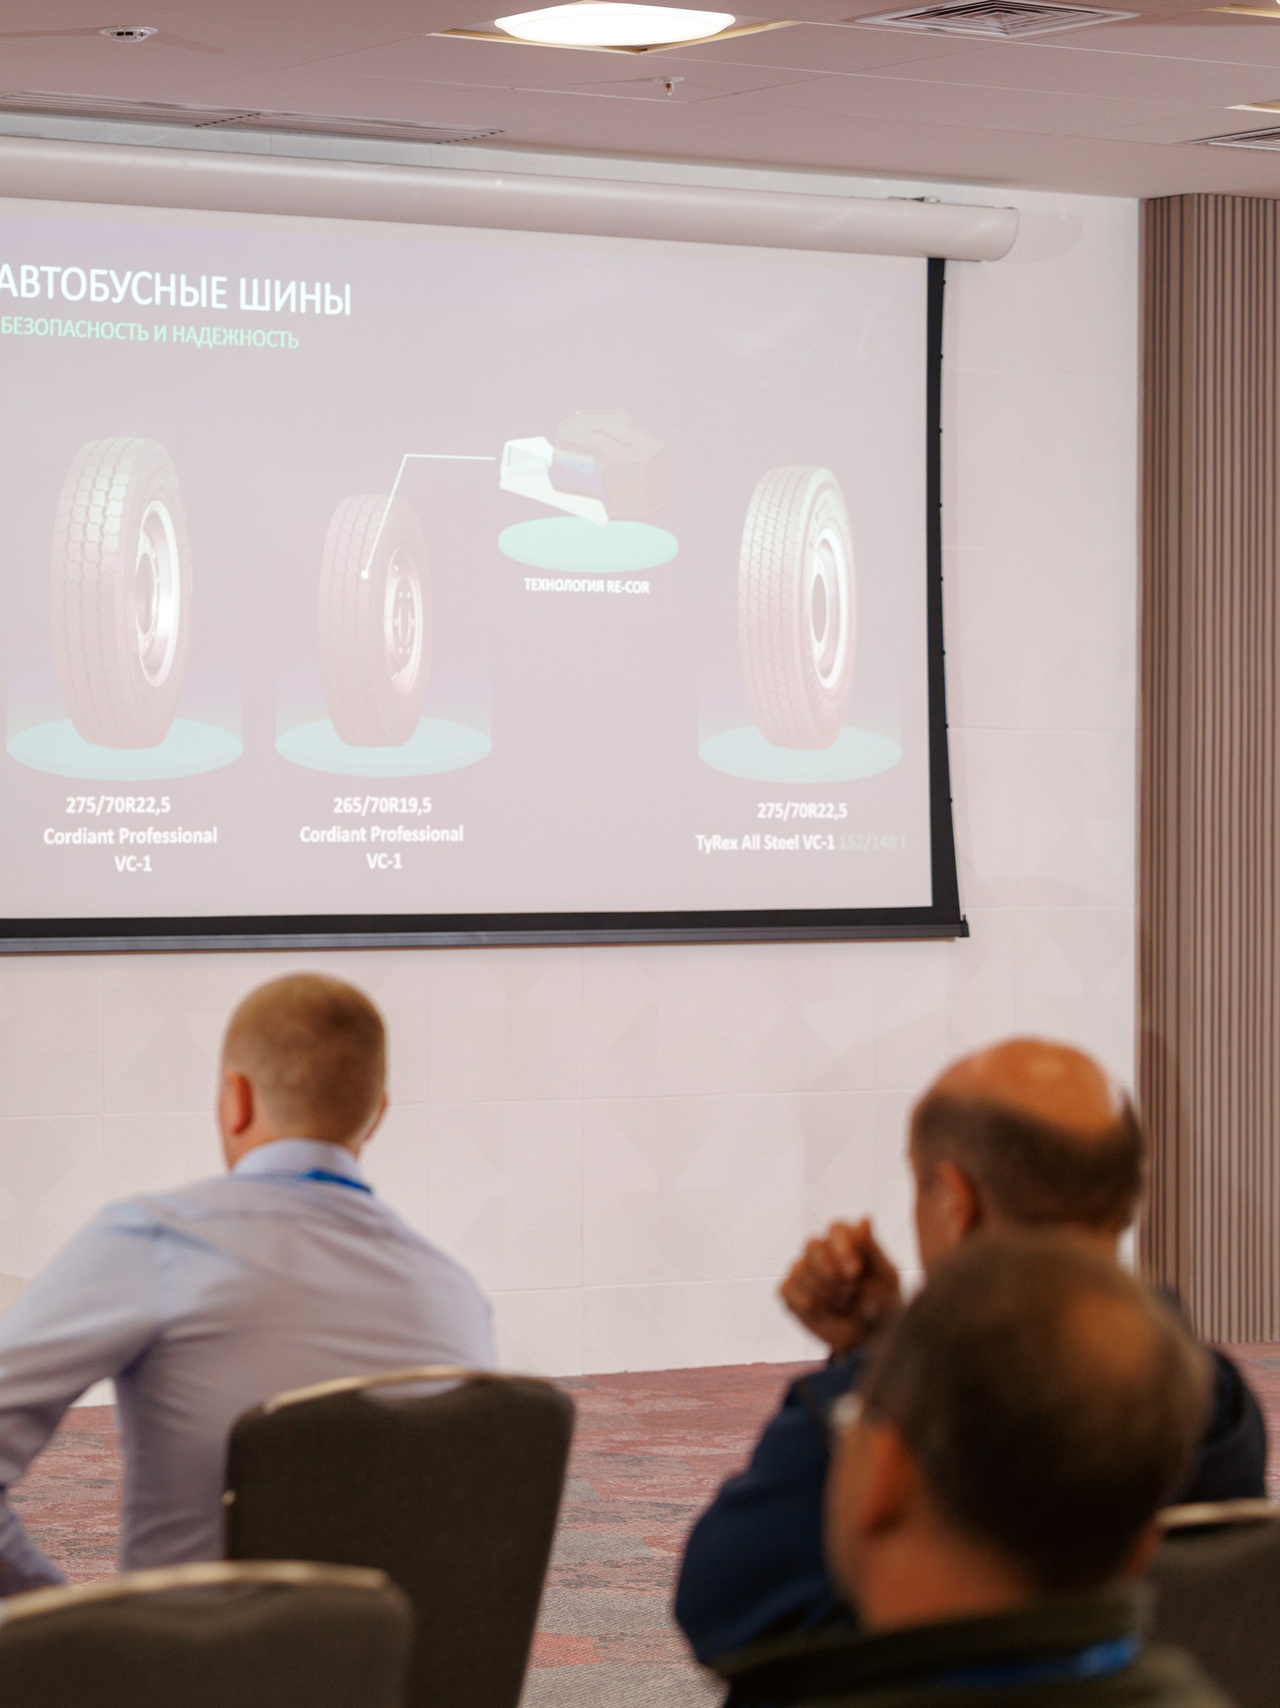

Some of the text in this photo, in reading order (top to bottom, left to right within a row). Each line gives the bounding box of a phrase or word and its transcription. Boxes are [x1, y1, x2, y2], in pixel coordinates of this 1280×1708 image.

[239, 277, 352, 316] ШИНЫ
[1, 316, 300, 349] БЕЗОПАСНОСТЬ И НАДЕЖНОСТЬ
[523, 577, 650, 594] ТЕХНОЛОГИЯ RE-COR
[66, 795, 171, 816] 275/70R22,5
[333, 796, 432, 816] 265/70R19,5
[757, 801, 848, 821] 275/70R22,5
[43, 826, 218, 845] Cordiant Professional
[299, 825, 464, 842] Cordiant Professional
[695, 834, 738, 854] TyRex
[741, 834, 760, 850] All
[763, 834, 799, 850] Steel
[802, 834, 836, 850] VC-1
[114, 855, 153, 872] VC-1
[366, 853, 403, 869] VC-1
